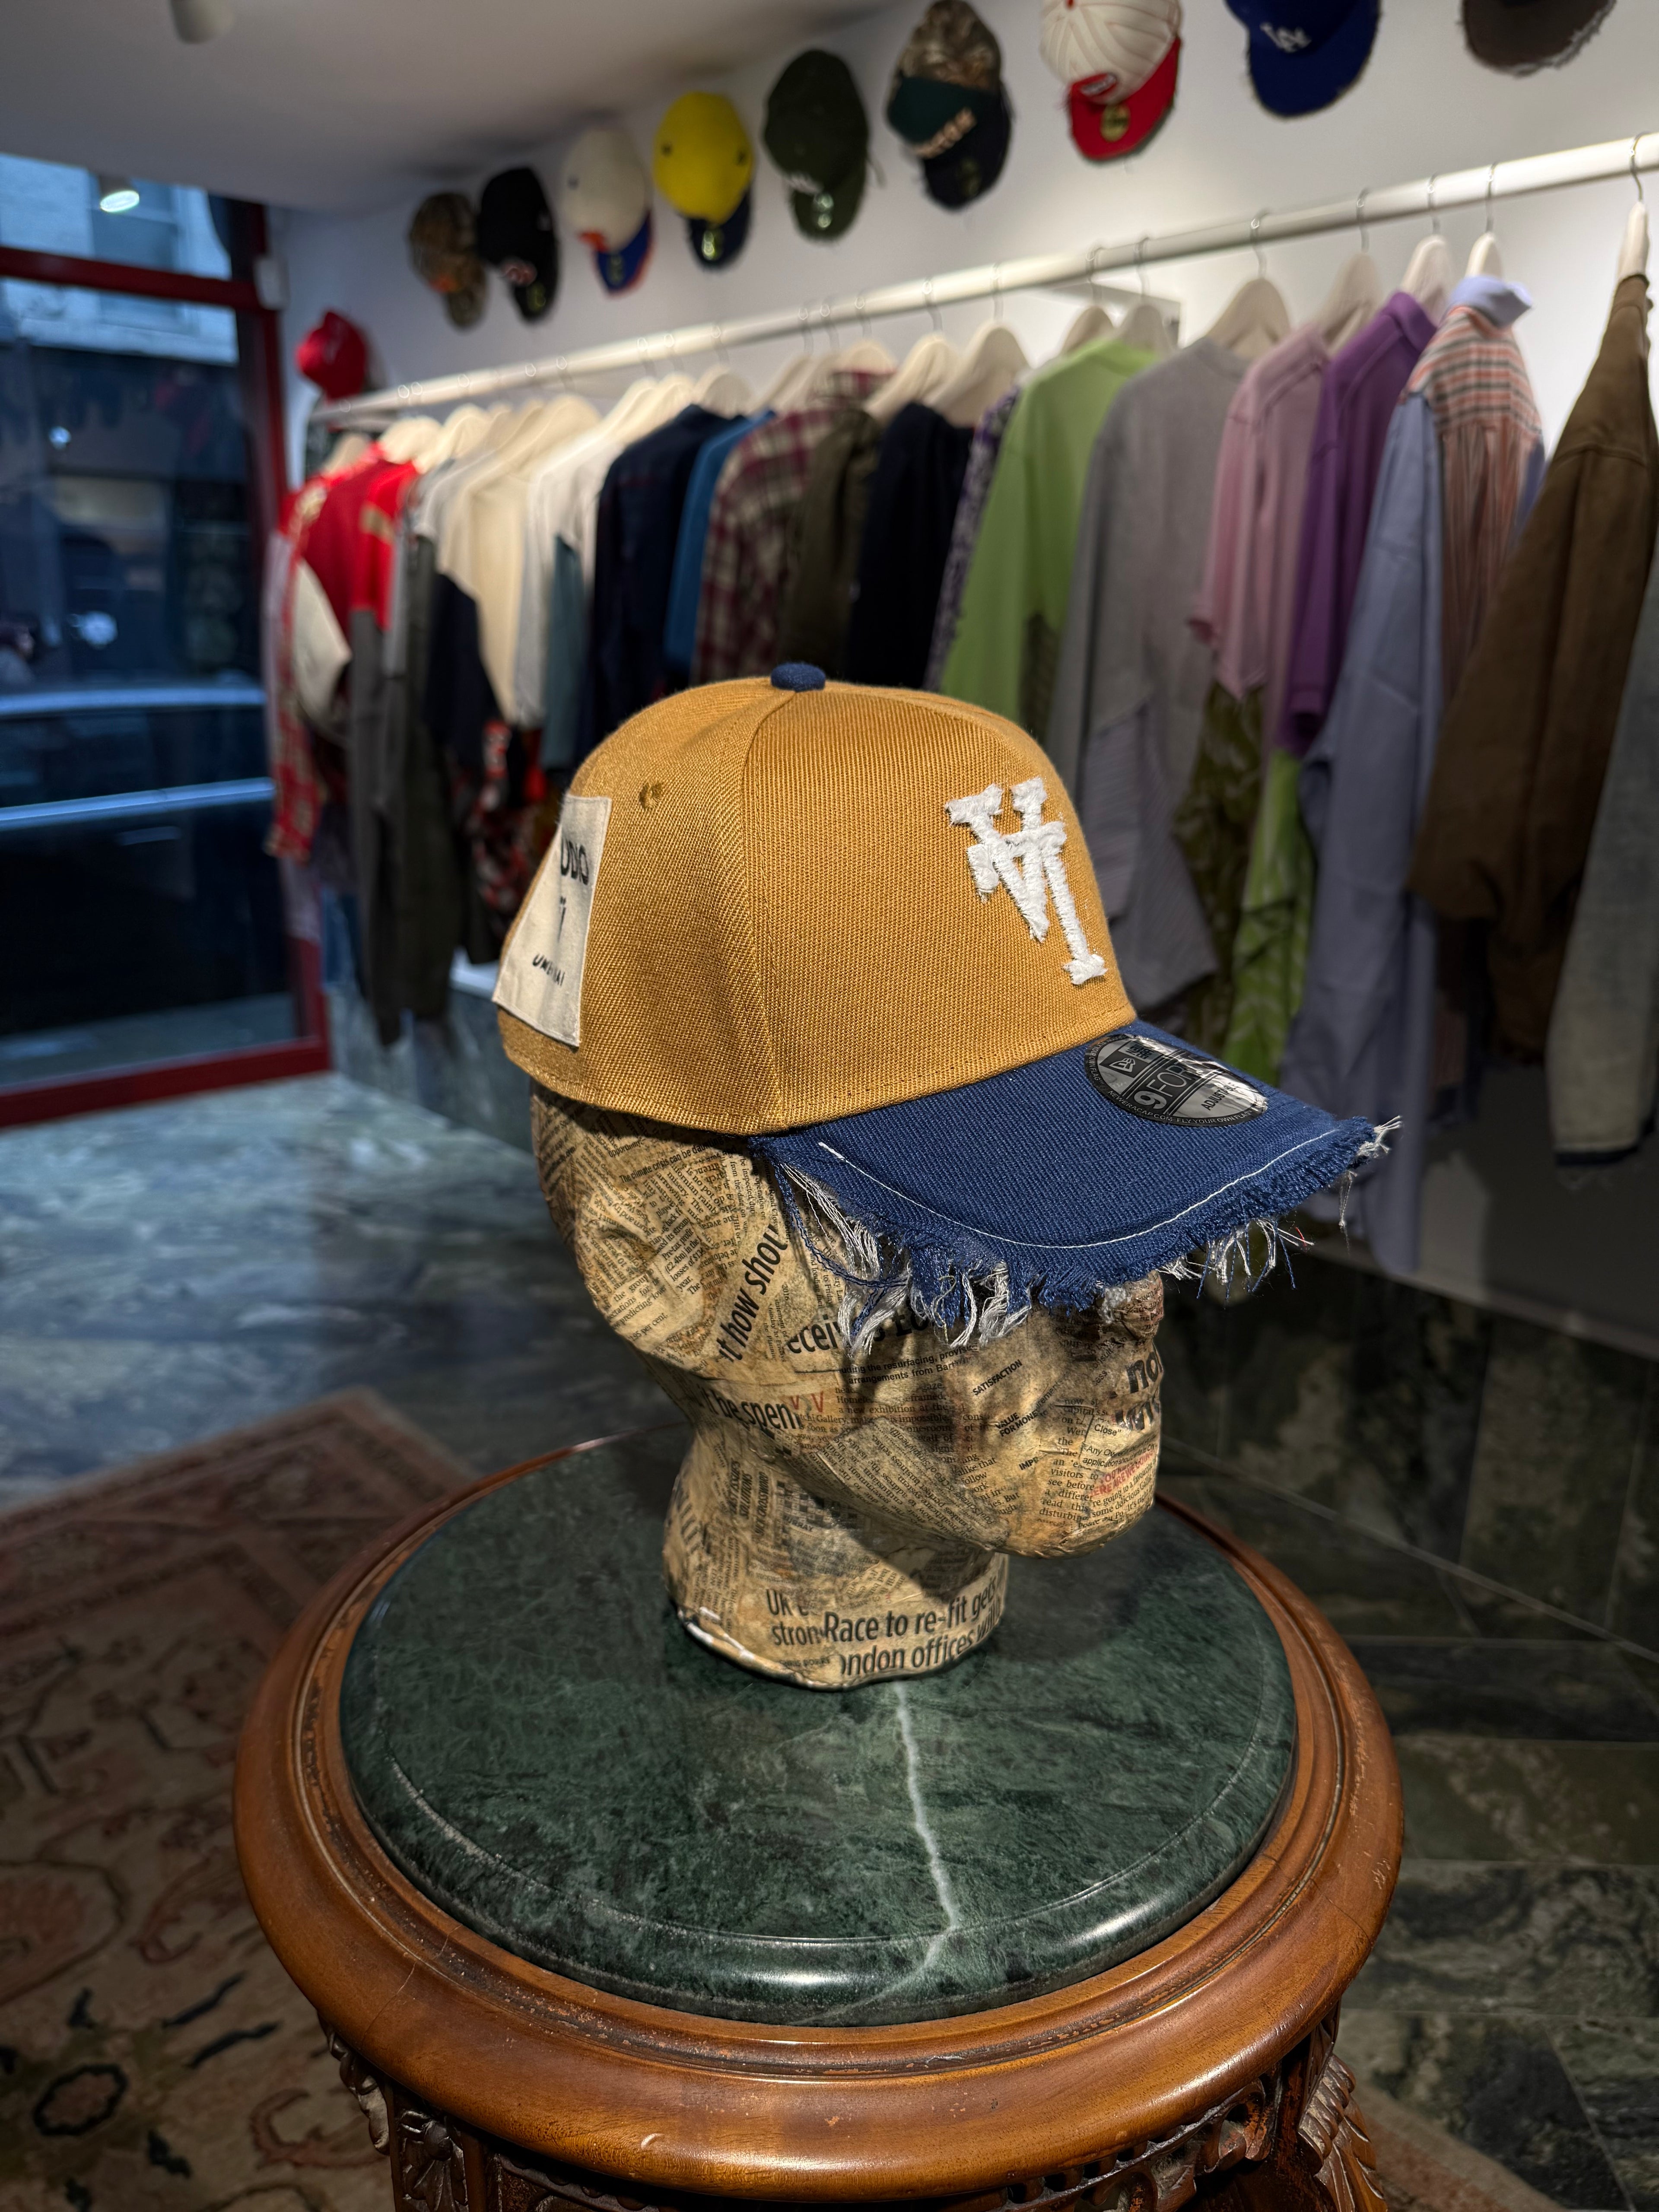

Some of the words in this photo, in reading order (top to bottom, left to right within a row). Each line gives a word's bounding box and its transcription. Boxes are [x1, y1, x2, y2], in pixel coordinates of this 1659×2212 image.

[619, 1172, 632, 1184] The
[631, 1166, 652, 1180] climate
[652, 1158, 670, 1171] crisis
[669, 1154, 682, 1164] can
[681, 1148, 691, 1160] be
[740, 1158, 746, 1166] be
[667, 1172, 690, 1199] misery.
[690, 1198, 705, 1214] The
[741, 1167, 754, 1203] inspected
[661, 1243, 682, 1260] Pre-tax
[680, 1228, 694, 1246] profit
[822, 1246, 836, 1260] the
[670, 1264, 690, 1282] losses
[688, 1257, 695, 1267] of
[822, 1274, 829, 1283] to
[613, 1290, 626, 1302] the
[639, 1285, 650, 1297] for
[687, 1282, 701, 1295] The
[620, 1298, 652, 1325] predicting
[720, 1287, 760, 1348] how
[868, 1362, 882, 1373] the
[884, 1353, 938, 1371] resurfacing,
[848, 1371, 909, 1385] arrangements
[912, 1366, 934, 1378] from
[972, 1359, 1023, 1395] SATISFACTION
[847, 1406, 864, 1414] new
[869, 1405, 916, 1414] exhibition
[932, 1402, 949, 1411] the
[817, 1414, 850, 1425] Gallery,
[995, 1412, 1020, 1430] VALUE
[807, 1425, 827, 1433] soon
[908, 1425, 951, 1433] one-room
[999, 1426, 1017, 1437] FOR
[846, 1437, 868, 1460] issues
[870, 1433, 893, 1457] sense.
[887, 1425, 931, 1468] Simplyhealth
[1058, 1437, 1073, 1446] the
[850, 1455, 859, 1465] as
[866, 1459, 881, 1474] the
[955, 1464, 978, 1476] alike
[978, 1457, 997, 1469] that
[1082, 1456, 1119, 1468] application
[837, 1467, 852, 1481] the
[889, 1454, 921, 1486] business
[927, 1465, 937, 1475] of
[961, 1471, 988, 1485] follow
[1051, 1468, 1084, 1479] visitors
[1090, 1471, 1099, 1481] to
[847, 1465, 891, 1506] government
[852, 1481, 862, 1491] to
[861, 1466, 903, 1507] enthusiasm
[879, 1472, 908, 1500] address
[895, 1473, 923, 1500] system.
[934, 1471, 950, 1488] CEO
[1047, 1478, 1063, 1487] see
[1066, 1478, 1095, 1491] before
[862, 1490, 879, 1505] due
[906, 1497, 917, 1508] to
[918, 1483, 946, 1510] perfect
[1004, 1492, 1020, 1503] But
[1103, 1489, 1122, 1506] going
[1122, 1485, 1130, 1494] to
[1042, 1498, 1063, 1508] read
[1071, 1501, 1089, 1512] this
[1091, 1506, 1114, 1519] some
[1116, 1491, 1140, 1510] delicious
[943, 1505, 968, 1529] makes
[824, 1610, 879, 1643] Race
[886, 1610, 908, 1638] to
[915, 1595, 968, 1635] re-fit
[911, 1627, 975, 1669] offices
